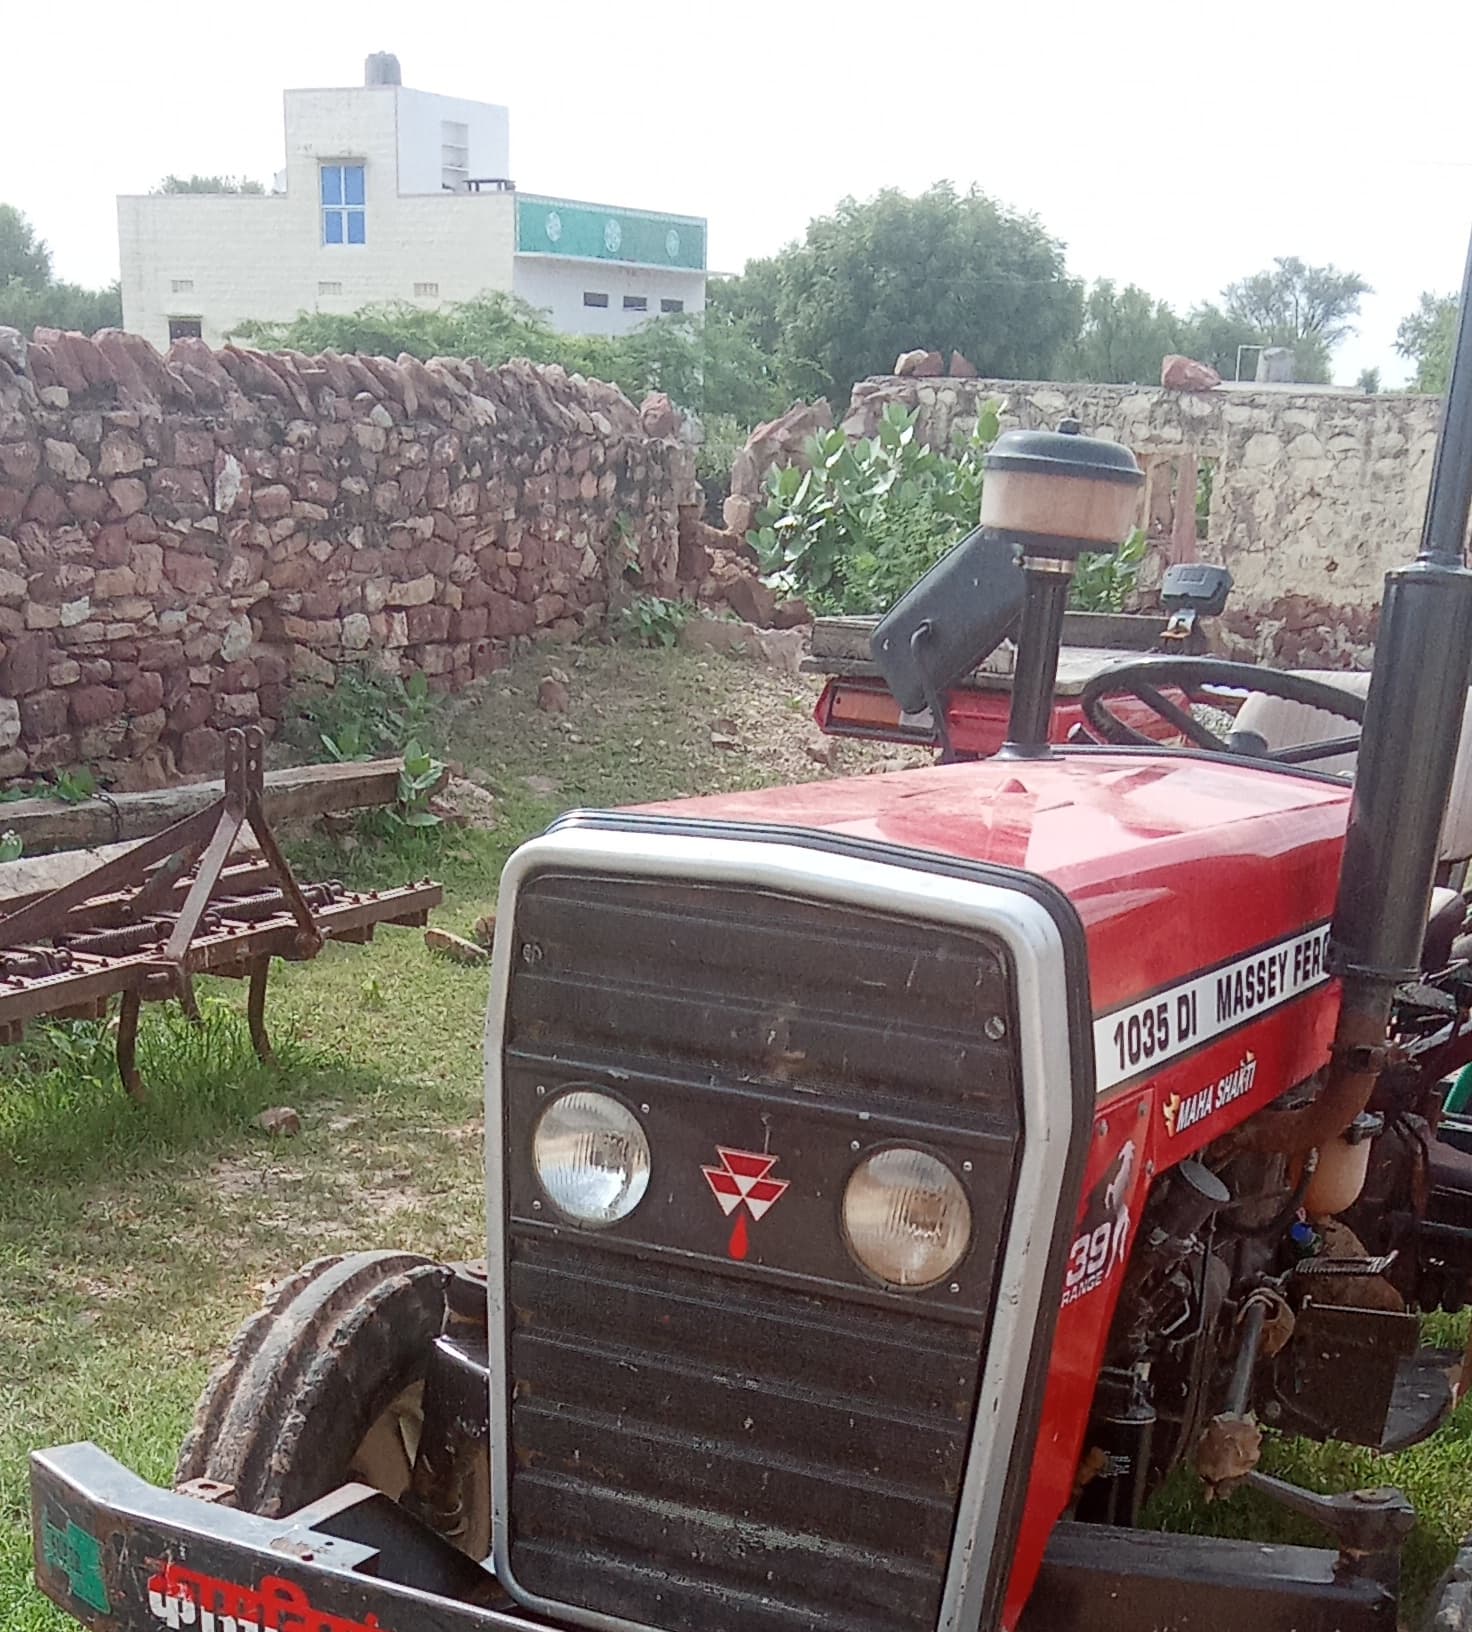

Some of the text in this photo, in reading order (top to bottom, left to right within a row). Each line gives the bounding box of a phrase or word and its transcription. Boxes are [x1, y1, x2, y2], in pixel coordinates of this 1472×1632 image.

[1113, 1002, 1170, 1071] 1035
[1177, 989, 1197, 1043] DI
[1216, 949, 1288, 1023] MASSEY
[1176, 1059, 1257, 1133] MAHA SHAKTI
[1066, 1222, 1111, 1287] 39
[1060, 1270, 1104, 1309] RANGE
